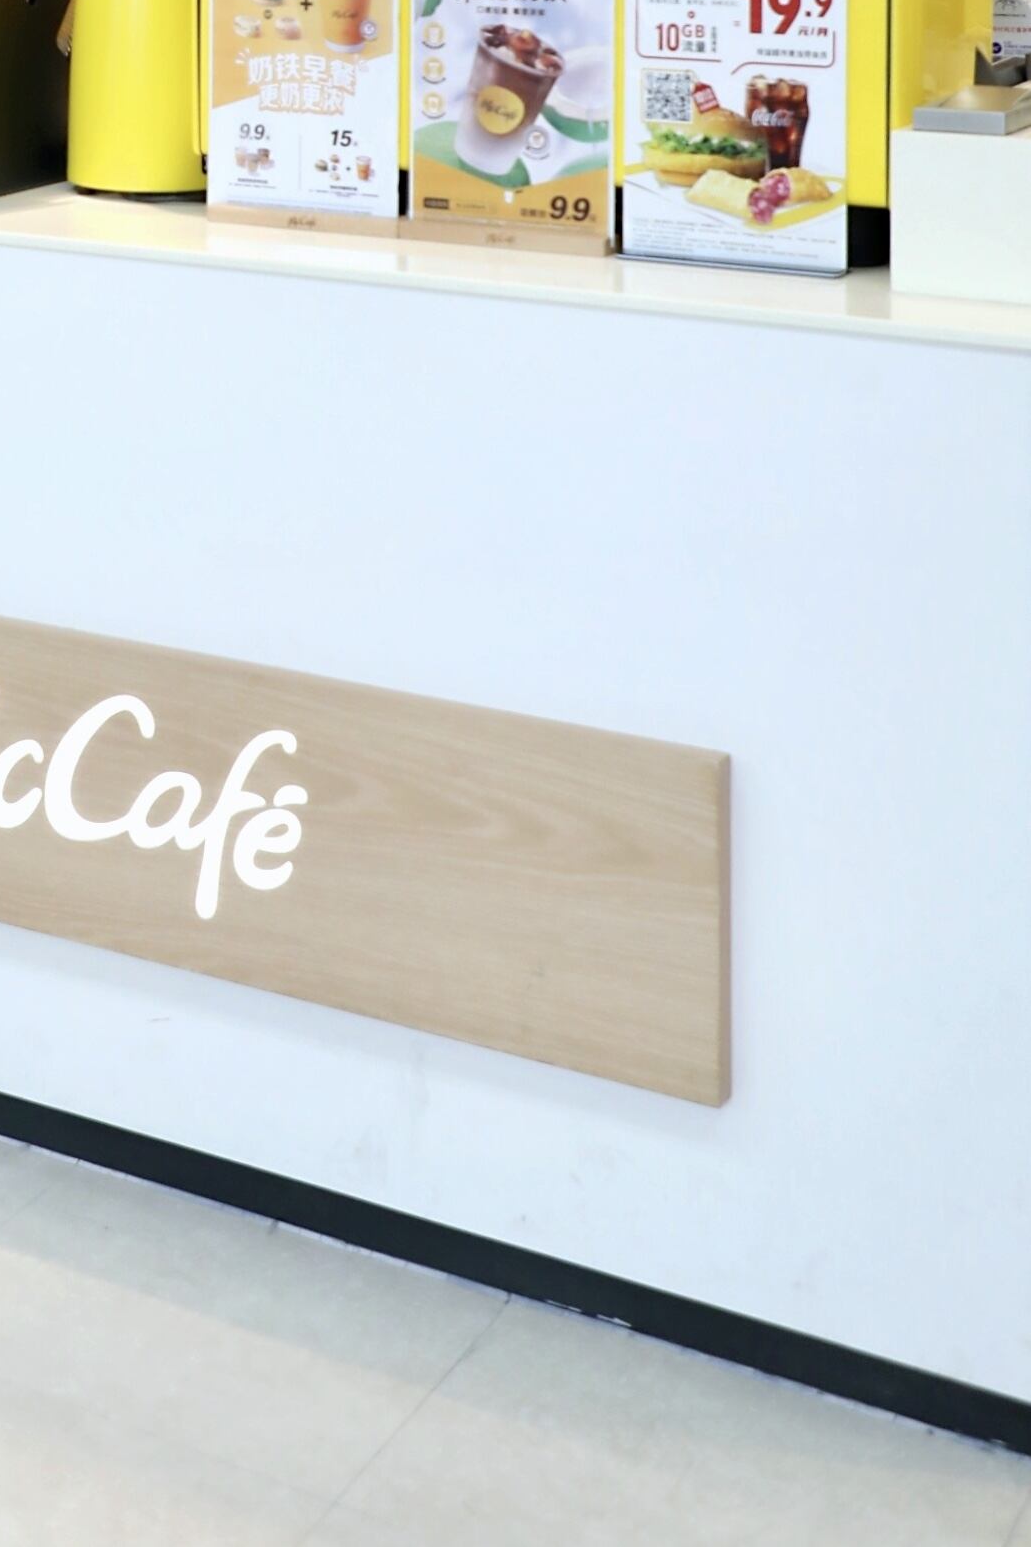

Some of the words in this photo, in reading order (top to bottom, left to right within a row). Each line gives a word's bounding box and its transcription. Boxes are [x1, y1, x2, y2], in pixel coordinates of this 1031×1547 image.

[656, 23, 679, 51] 10
[239, 123, 266, 141] 9.9
[331, 129, 353, 147] 15
[549, 195, 591, 221] 9.9
